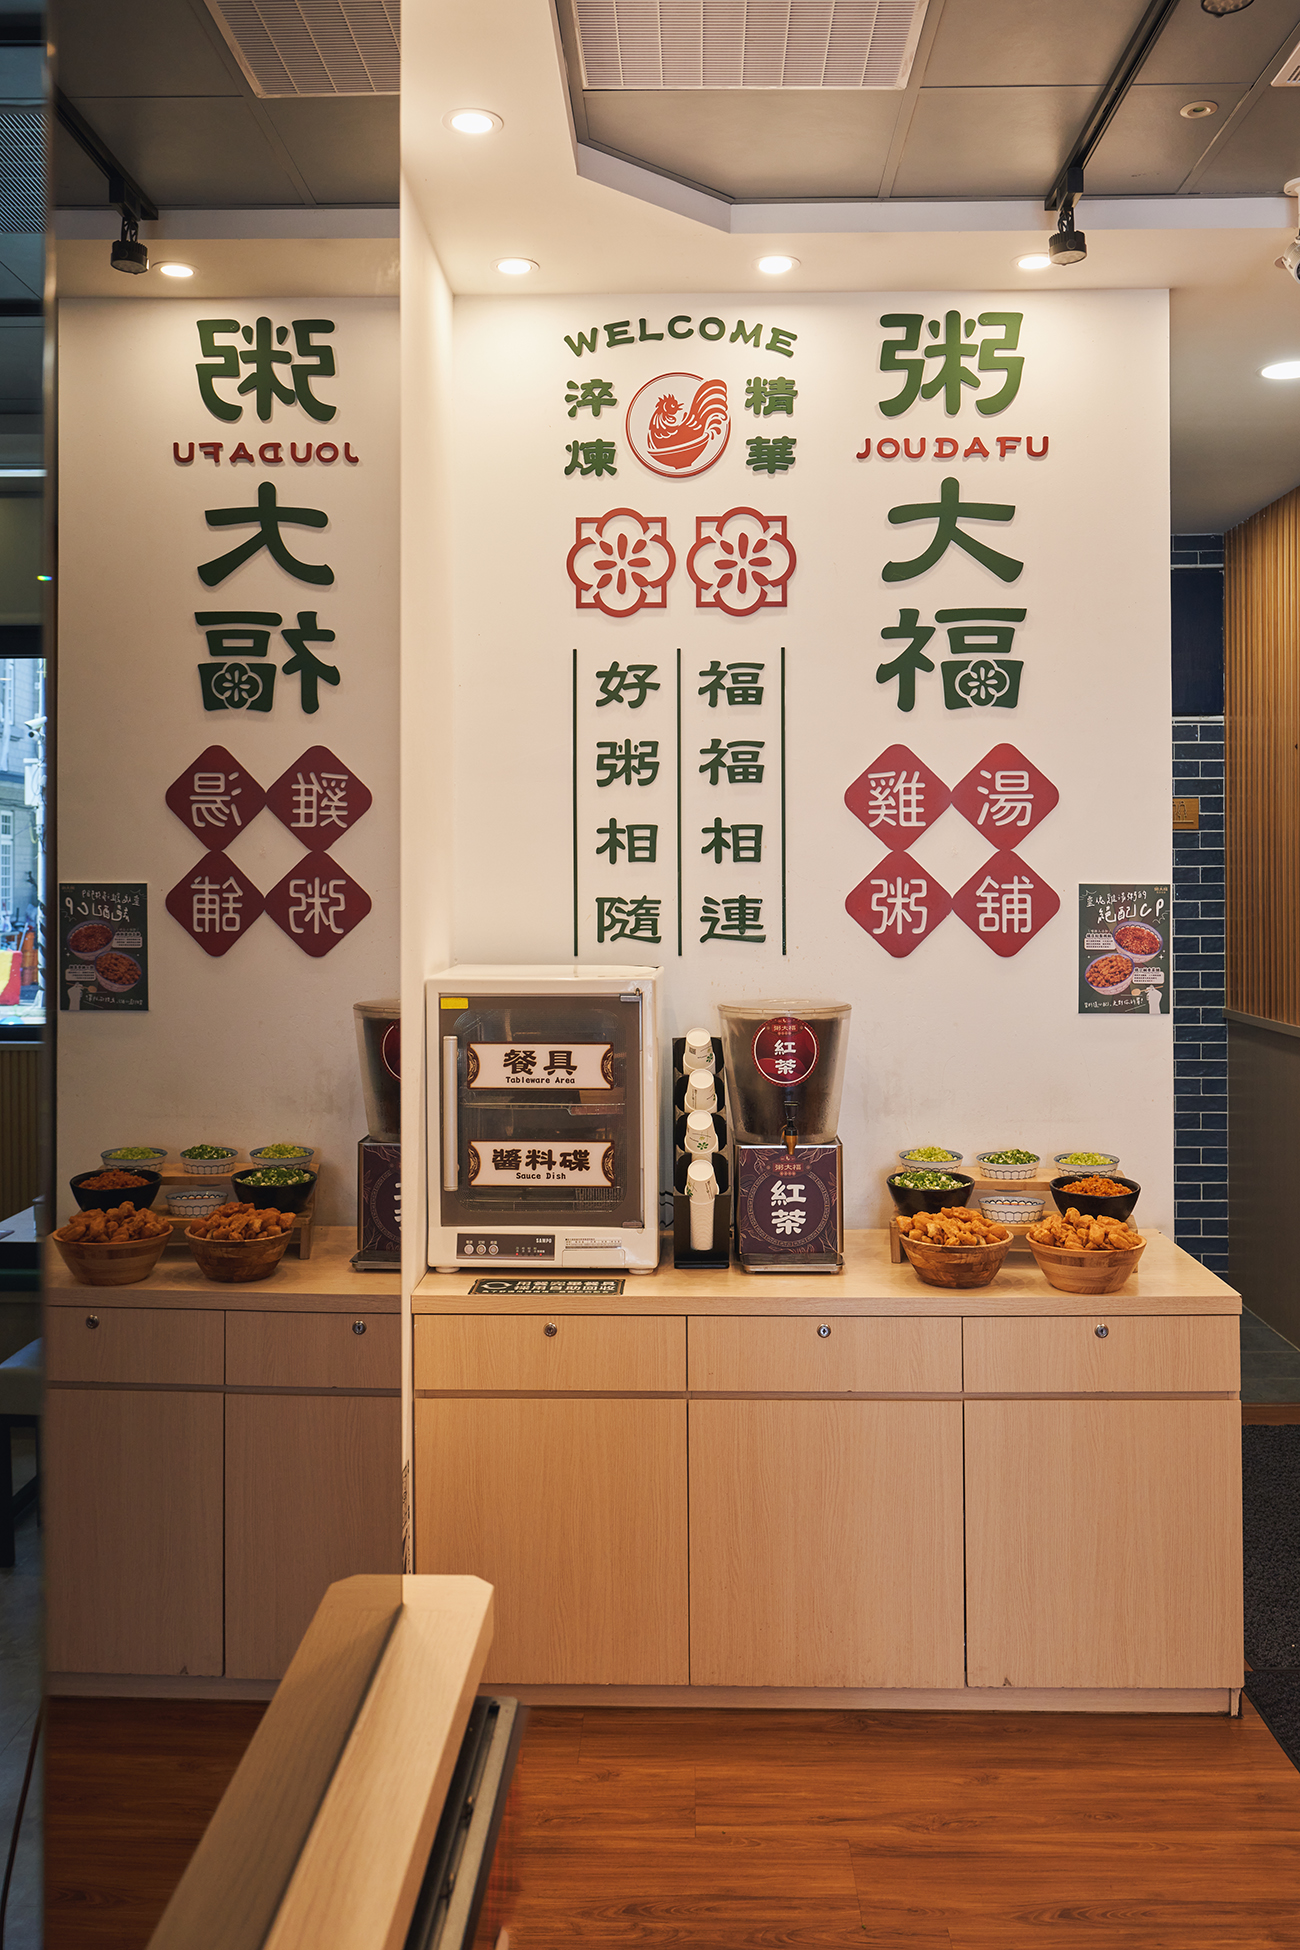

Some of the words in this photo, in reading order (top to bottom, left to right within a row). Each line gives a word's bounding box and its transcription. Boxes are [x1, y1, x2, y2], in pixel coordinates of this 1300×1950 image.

[563, 314, 798, 358] WELCOME
[856, 435, 1050, 460] JOUDAFU
[595, 660, 662, 944] 好粥相隨
[697, 660, 767, 944] 福福相連
[503, 1049, 578, 1076] 餐具
[774, 1039, 796, 1075] 紅茶
[505, 1076, 551, 1085] Tableware
[554, 1076, 575, 1085] Area
[491, 1148, 591, 1172] 醬料碟
[515, 1172, 541, 1181] Sauce
[545, 1172, 566, 1181] Dish
[770, 1179, 807, 1235] 紅茶
